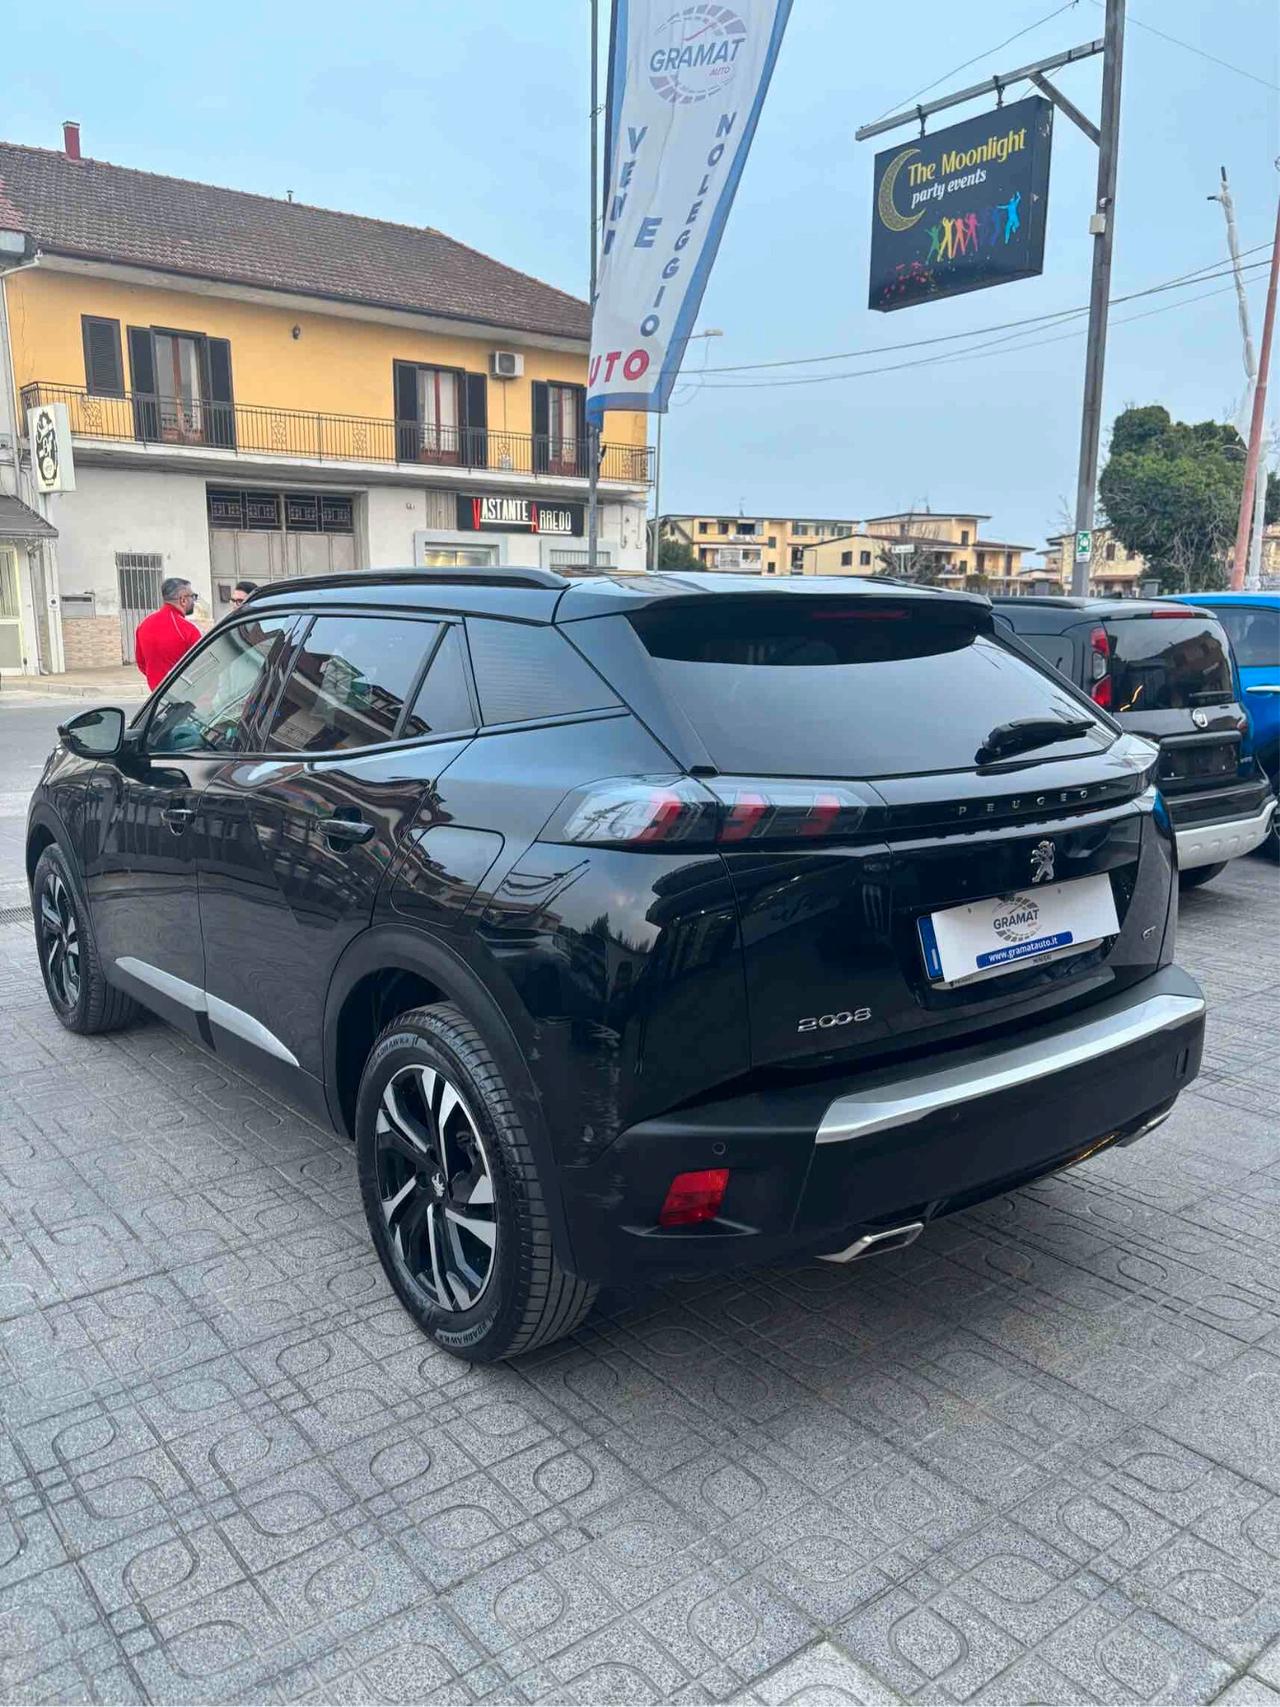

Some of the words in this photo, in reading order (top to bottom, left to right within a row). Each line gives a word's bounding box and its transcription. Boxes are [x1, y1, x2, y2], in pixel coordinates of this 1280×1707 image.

[650, 38, 746, 72] GRAMAT
[709, 66, 731, 76] AUTO
[908, 161, 936, 187] The
[941, 128, 1027, 175] Moonlight
[911, 183, 946, 209] party
[947, 168, 987, 192] events
[634, 217, 663, 248] E
[640, 112, 737, 338] NOLEGGIO
[472, 497, 529, 530] VASTANTE
[530, 502, 572, 533] ARREDO
[993, 908, 1040, 931] GRAMAT
[988, 936, 1058, 963] www.gramatauto.it
[797, 1007, 872, 1032] 2008
